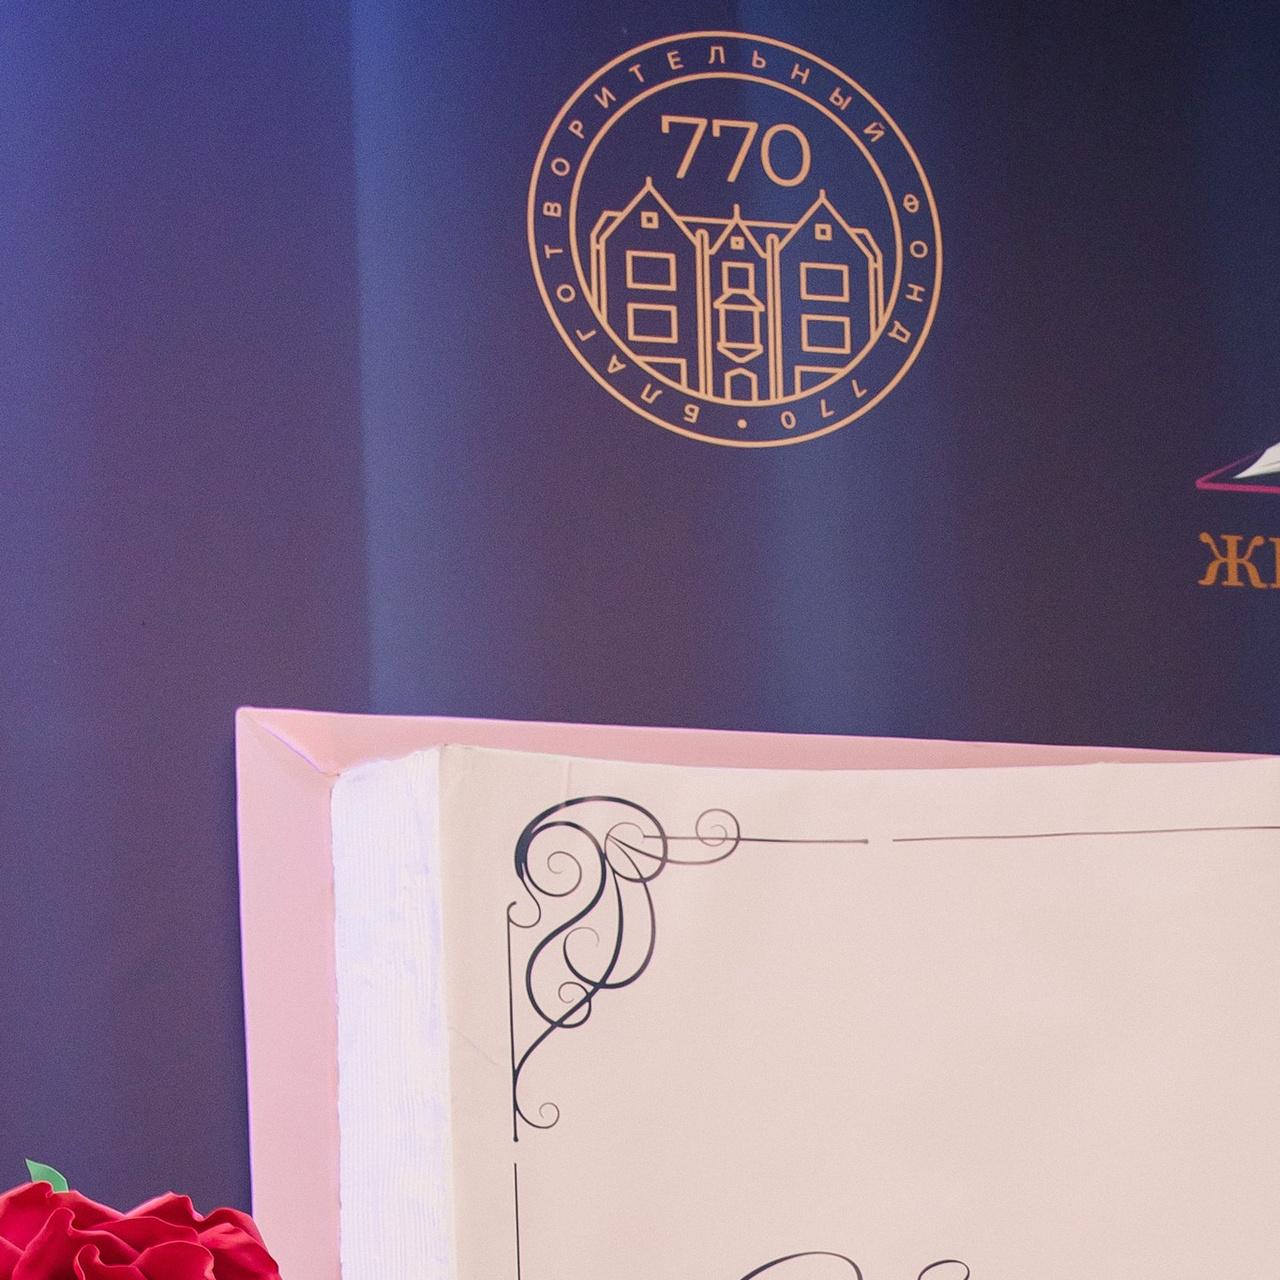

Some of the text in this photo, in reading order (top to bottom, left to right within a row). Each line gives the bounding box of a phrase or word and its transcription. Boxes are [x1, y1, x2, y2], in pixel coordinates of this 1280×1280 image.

[544, 46, 929, 429] БЛАГОТВОРИТЕЛЬНЫЙ ФОНД 770
[661, 115, 811, 186] 770
